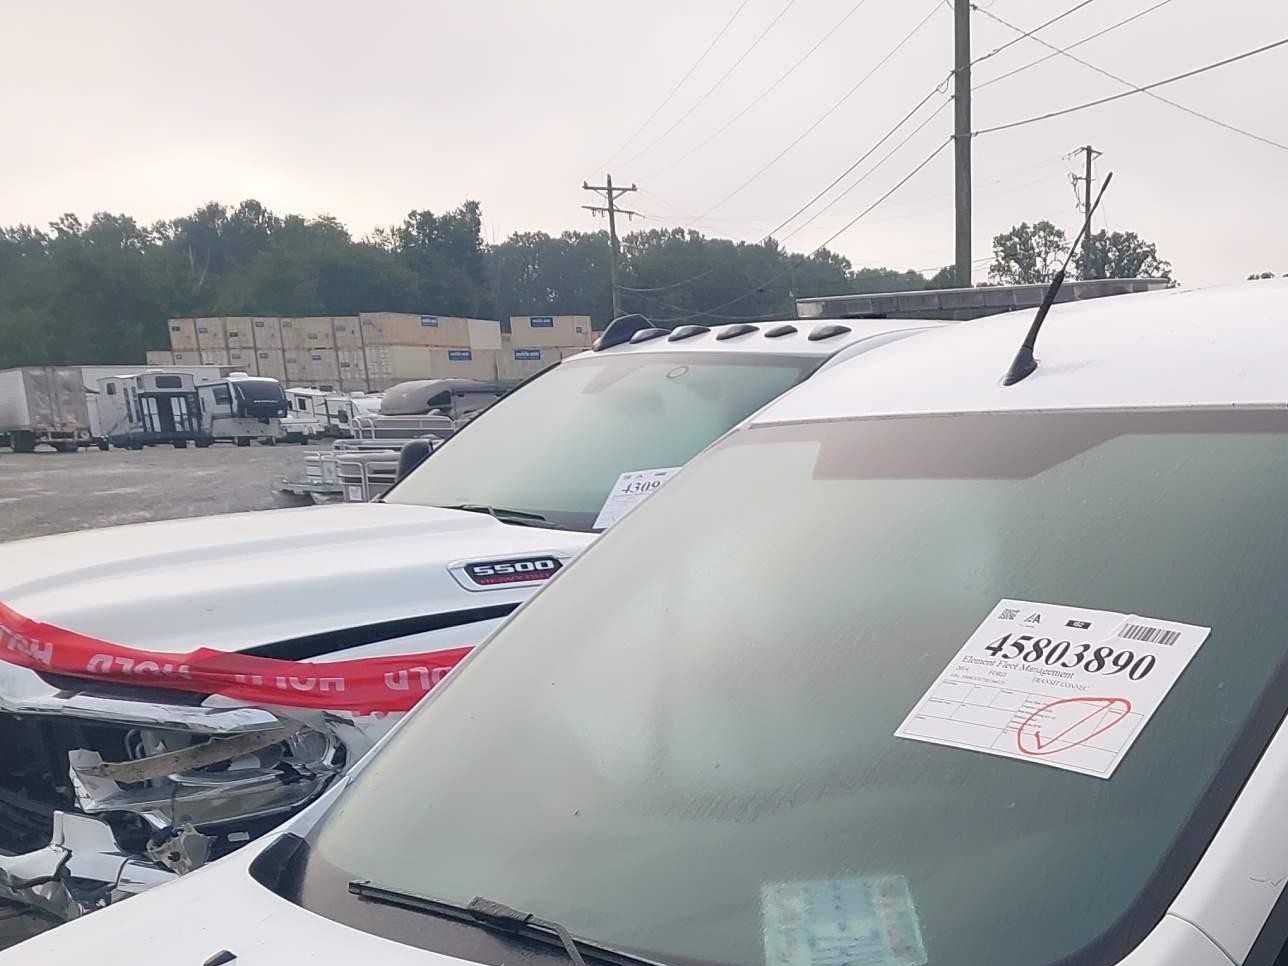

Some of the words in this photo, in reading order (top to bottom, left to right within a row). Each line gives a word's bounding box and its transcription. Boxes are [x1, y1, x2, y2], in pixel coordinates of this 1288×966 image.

[473, 560, 555, 576] 5500
[962, 655, 997, 667] Element
[996, 660, 1018, 671] Fleet
[1018, 663, 1075, 680] Management
[985, 633, 1156, 681] 45803890
